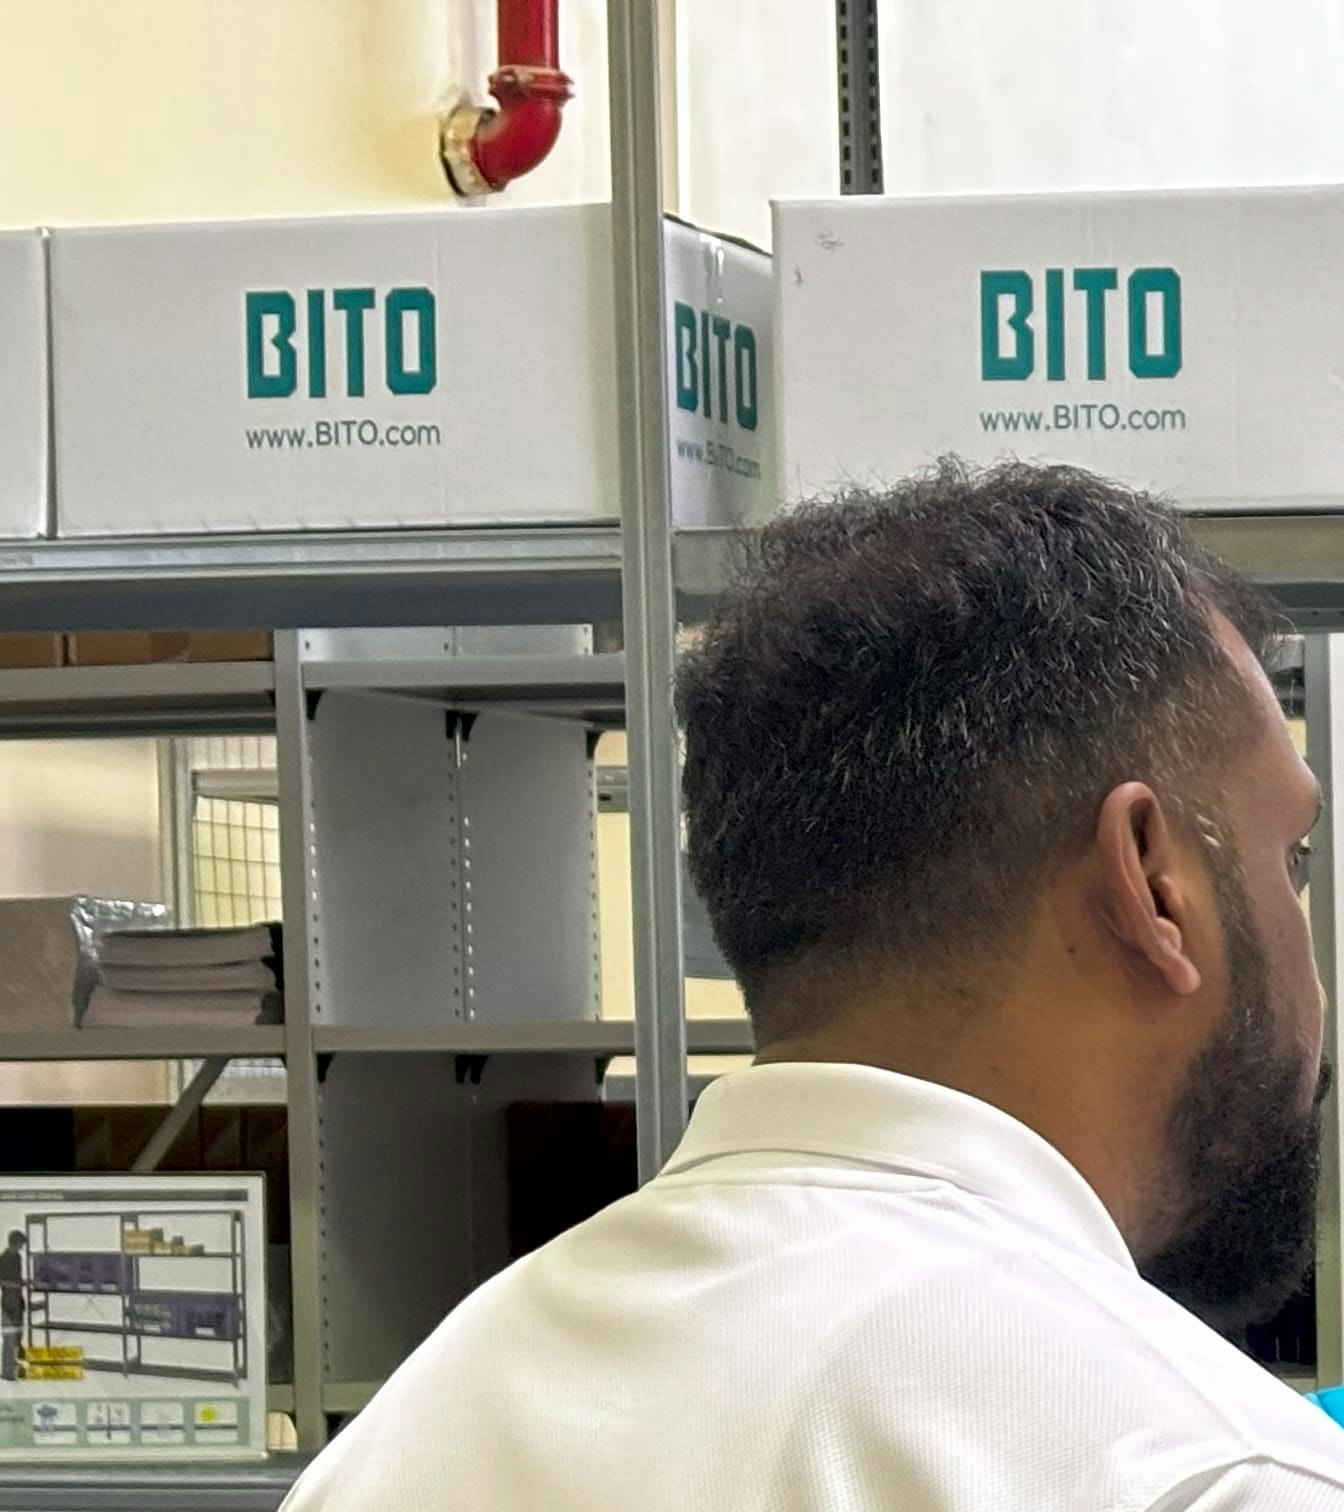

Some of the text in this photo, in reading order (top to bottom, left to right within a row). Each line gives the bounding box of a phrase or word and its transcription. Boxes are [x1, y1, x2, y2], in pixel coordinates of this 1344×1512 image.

[246, 286, 437, 399] BITO
[675, 301, 758, 432] BITO
[980, 267, 1182, 381] BITO
[245, 419, 441, 450] www.BITO.com
[980, 403, 1187, 433] www.BITO.com
